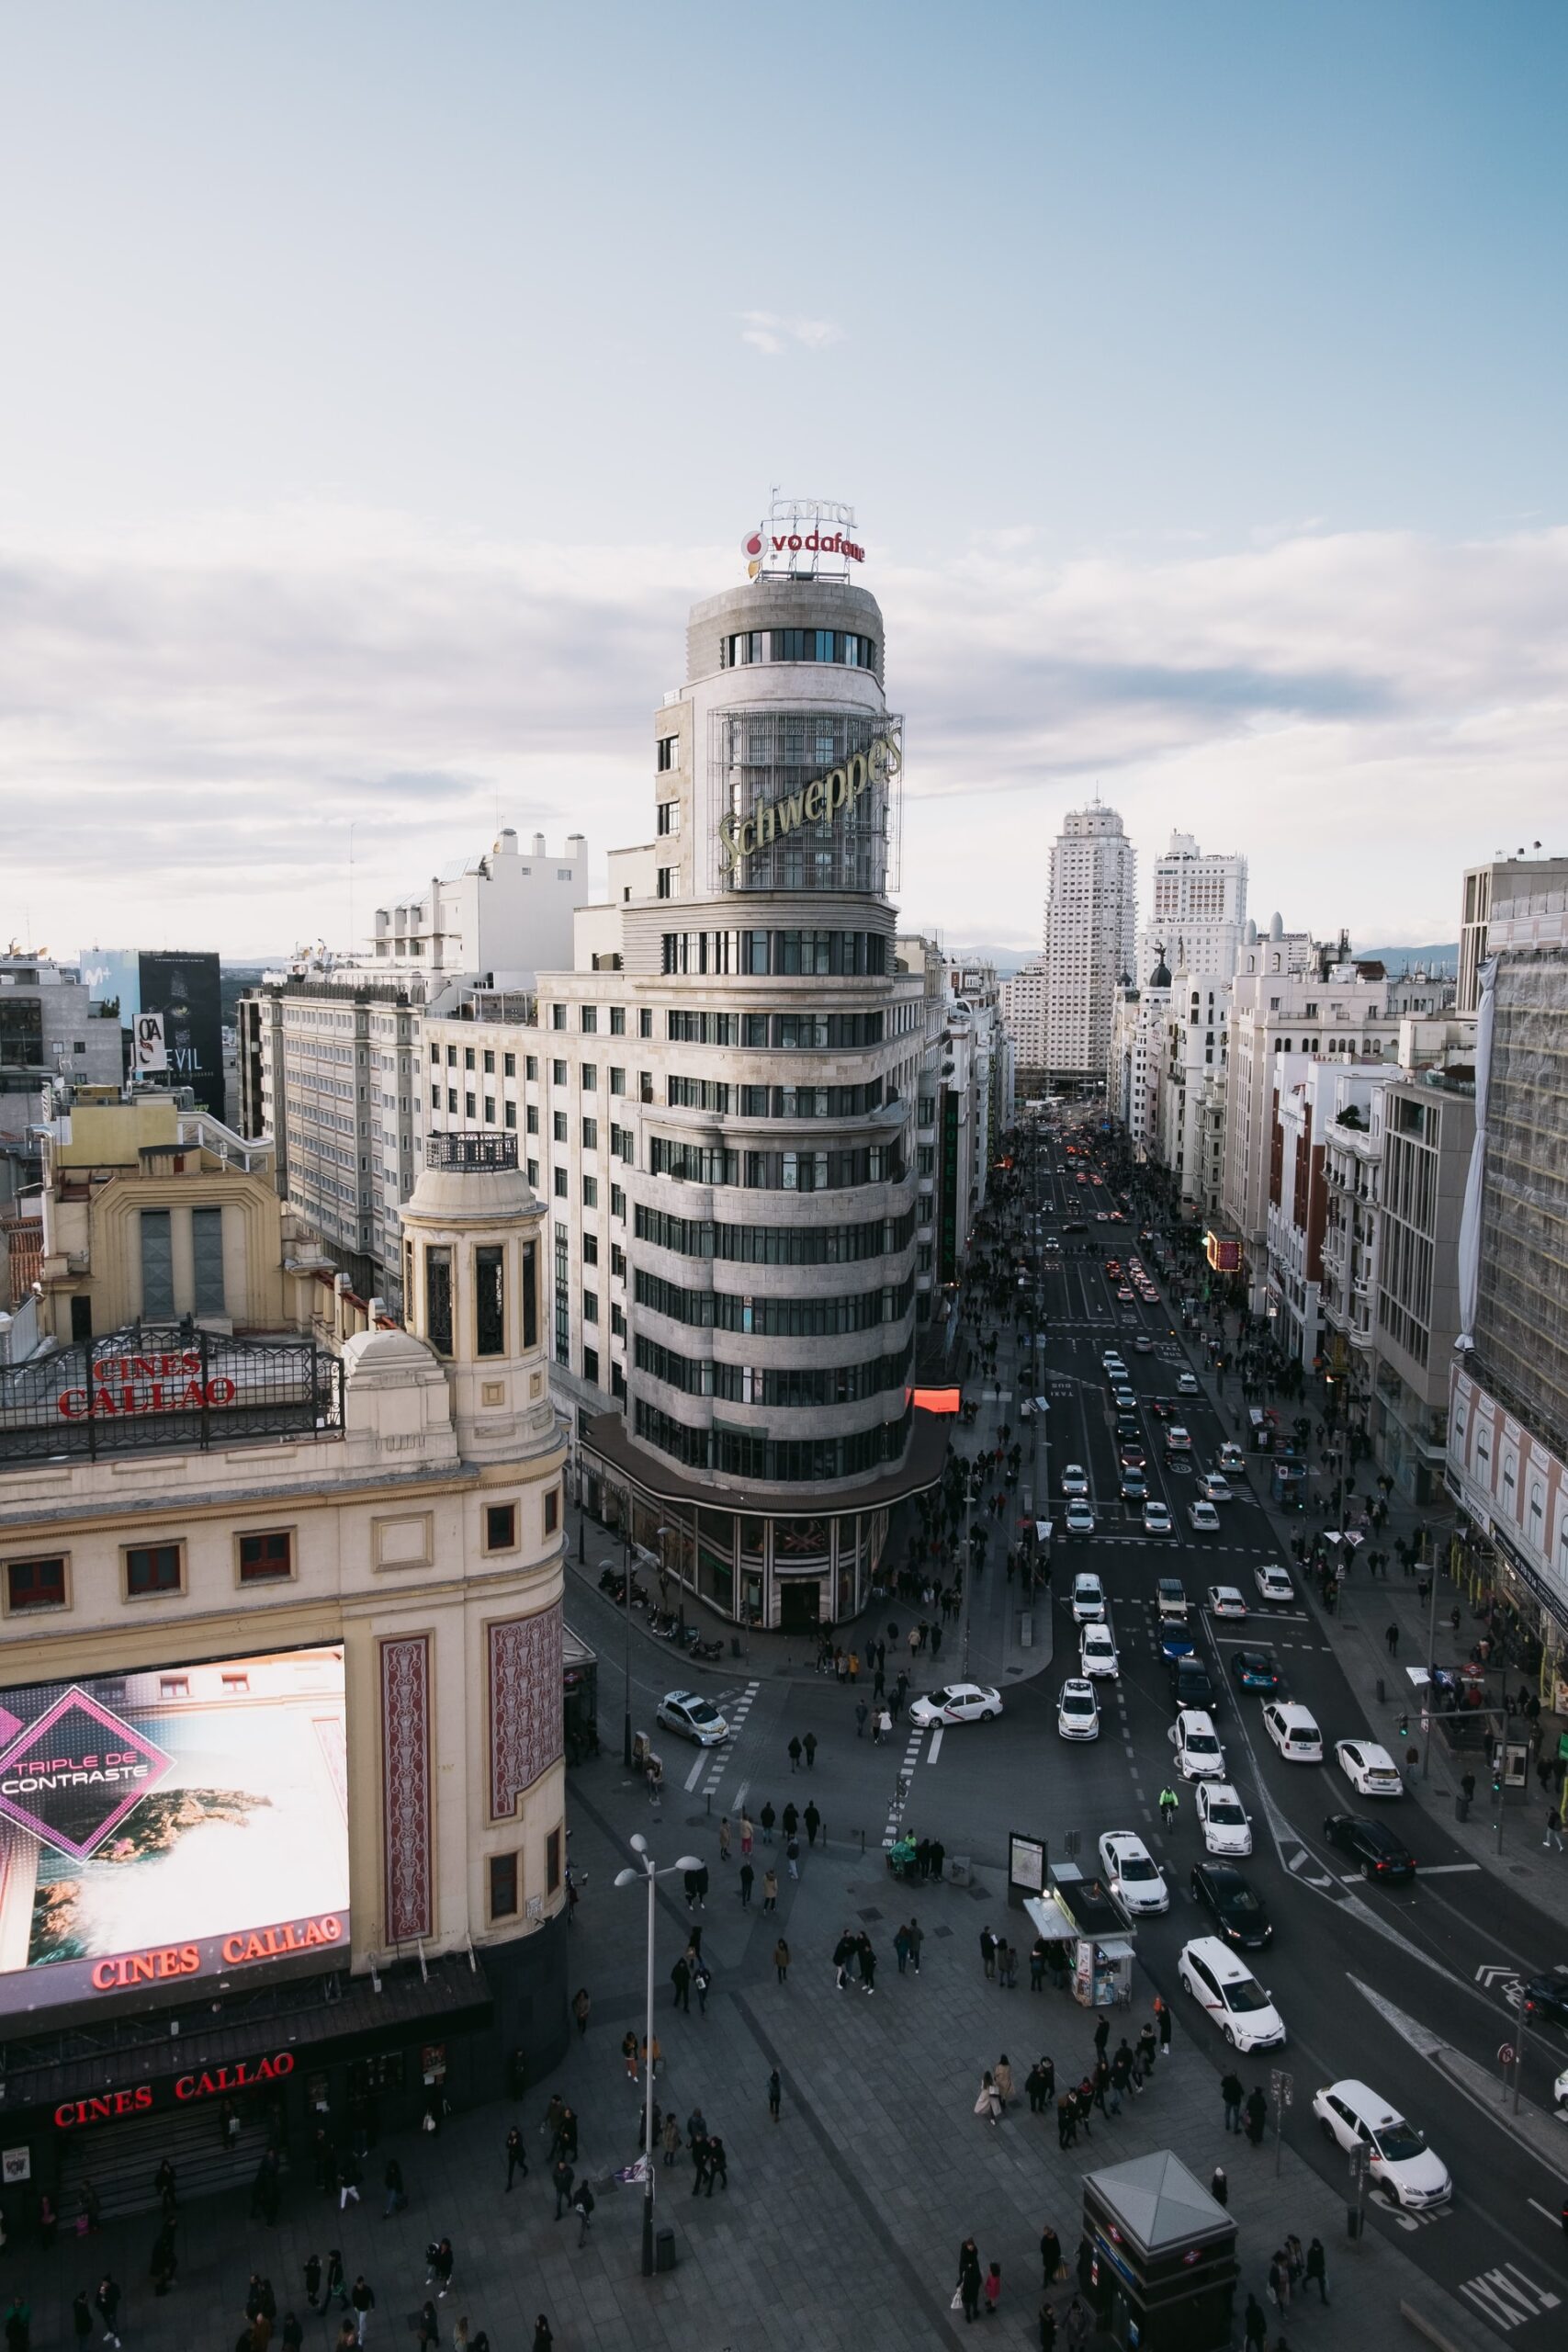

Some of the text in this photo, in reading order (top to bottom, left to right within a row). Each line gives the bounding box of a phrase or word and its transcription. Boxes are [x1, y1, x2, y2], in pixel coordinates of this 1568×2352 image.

[769, 499, 858, 528] CAPITOL
[772, 530, 865, 562] vodafone
[719, 727, 901, 874] Schweppes
[987, 1055, 997, 1097] HOTEL
[943, 1111, 956, 1263] HOTEL REX
[94, 1351, 201, 1382] CINES
[59, 1377, 236, 1418] CALLAO
[2, 1764, 149, 1794] CONTRASTE
[13, 1750, 137, 1777] TRIPLE DE
[93, 1915, 342, 1990] CINES CALLAO
[54, 2052, 295, 2127] CINES CALLAO
[1459, 2261, 1562, 2331] TAXI
